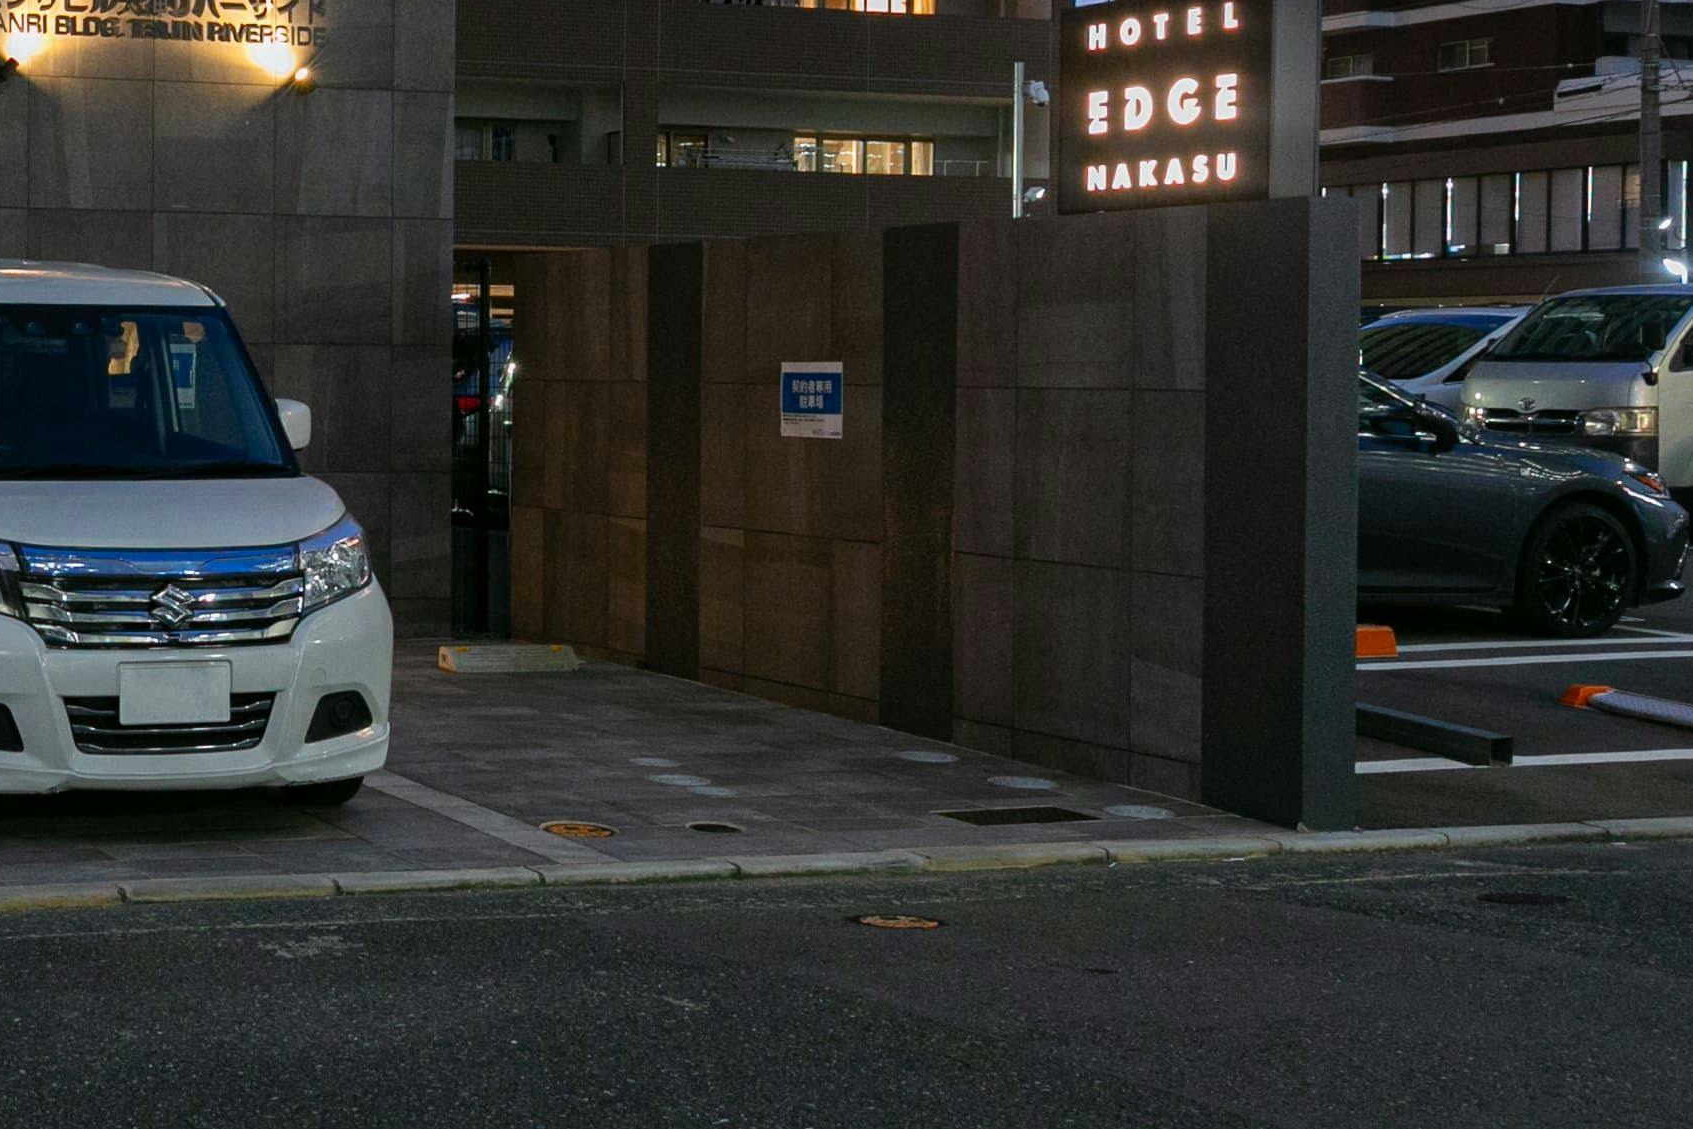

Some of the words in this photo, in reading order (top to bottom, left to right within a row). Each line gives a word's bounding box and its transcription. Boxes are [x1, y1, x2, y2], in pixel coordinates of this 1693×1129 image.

[126, 18, 204, 42] TENJIN
[207, 21, 326, 48] RIVERSIDE
[1088, 1, 1239, 51] HOTEL
[1088, 73, 1238, 135] EDGE
[1086, 152, 1237, 192] NAKASU
